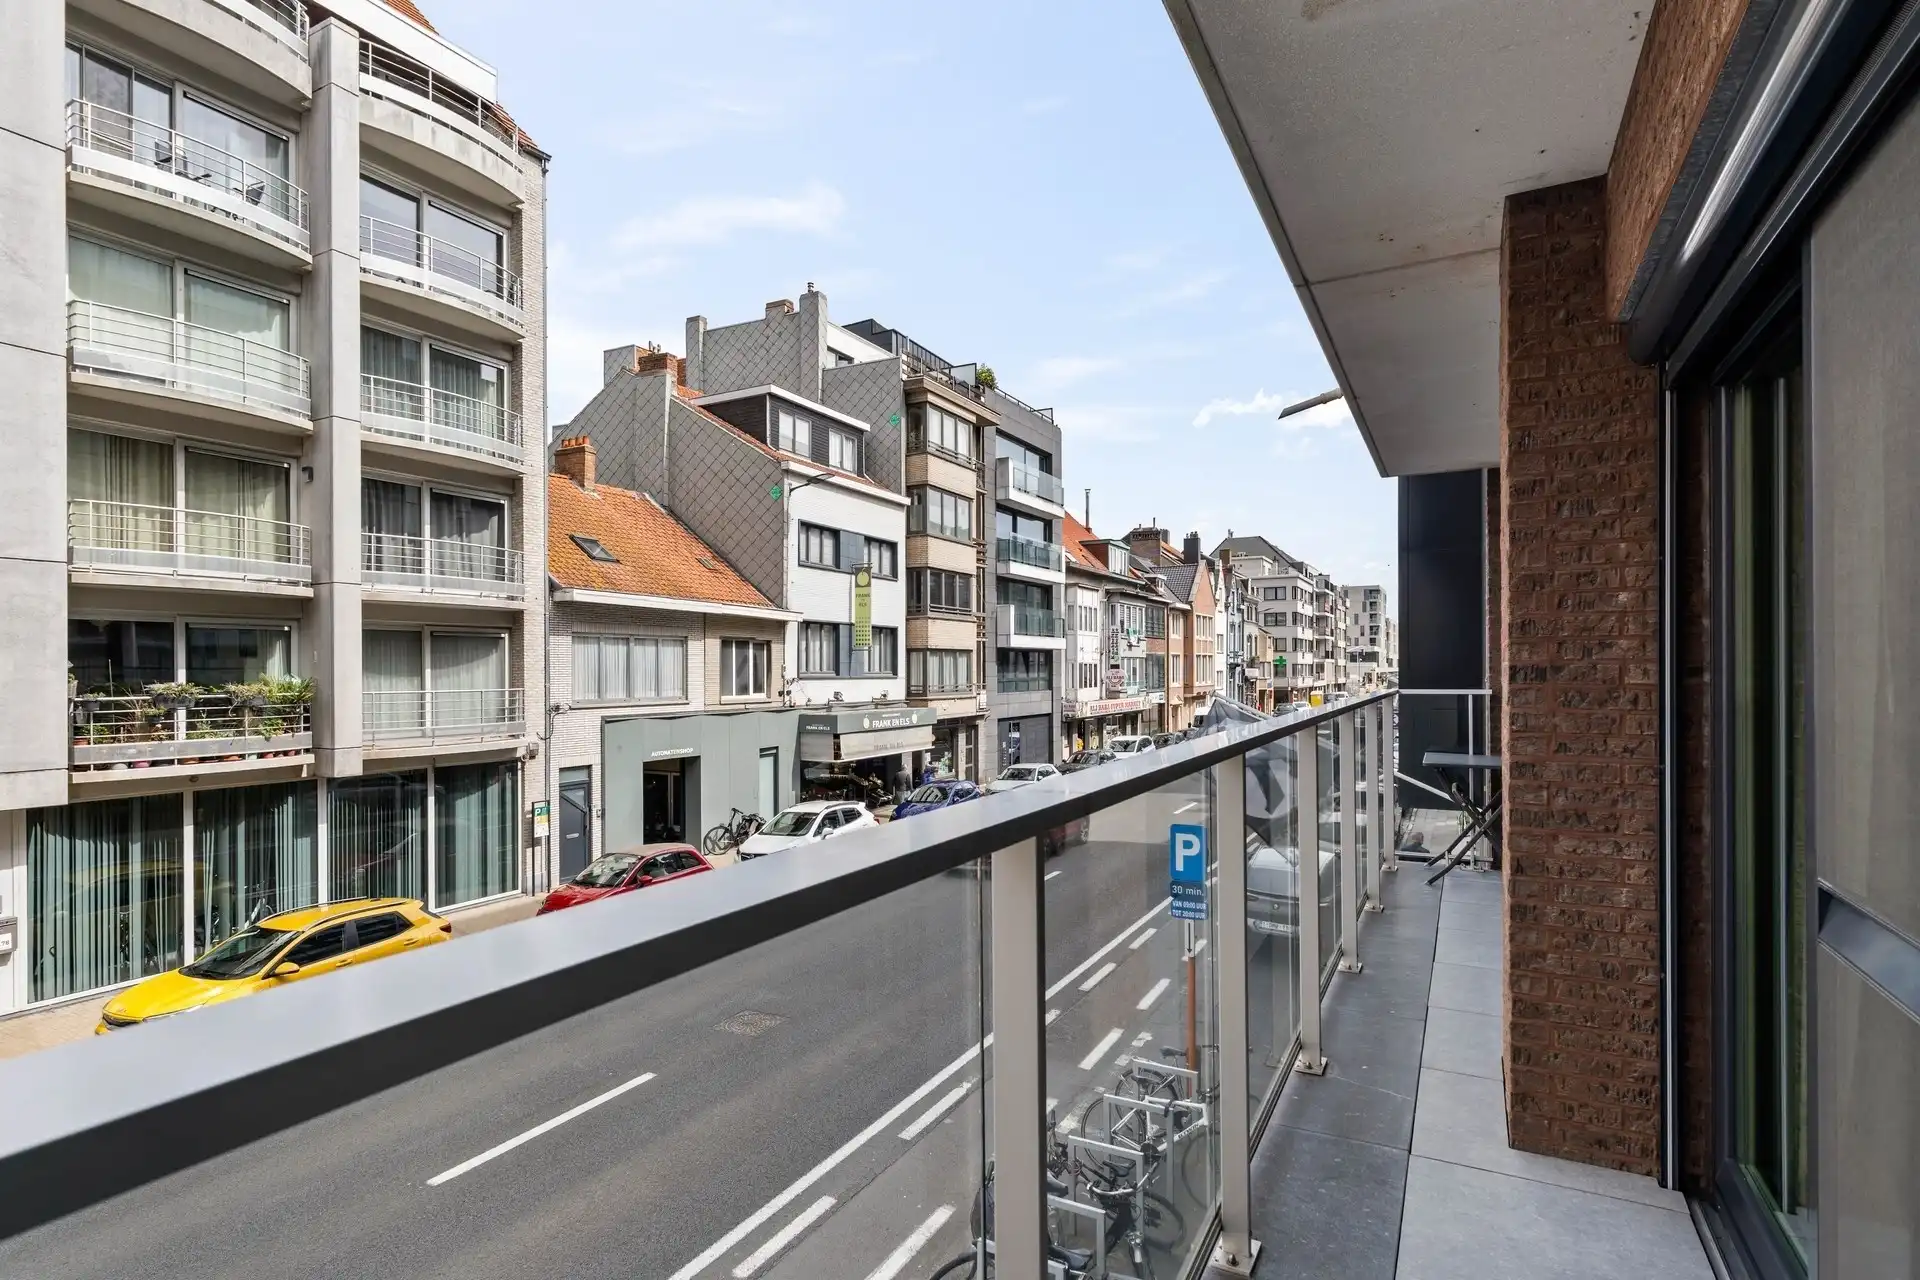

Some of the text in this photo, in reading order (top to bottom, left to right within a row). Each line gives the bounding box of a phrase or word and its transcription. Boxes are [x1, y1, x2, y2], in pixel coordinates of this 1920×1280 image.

[872, 717, 910, 729] FRANK EN ELS
[651, 747, 694, 757] AUTOMATENSHOP
[535, 808, 541, 816] P
[1175, 833, 1201, 872] P
[1172, 885, 1204, 896] 30 min.
[1172, 900, 1182, 908] VAN
[1196, 902, 1206, 910] UUR
[1172, 909, 1182, 917] TOT
[1195, 911, 1206, 919] UUR
